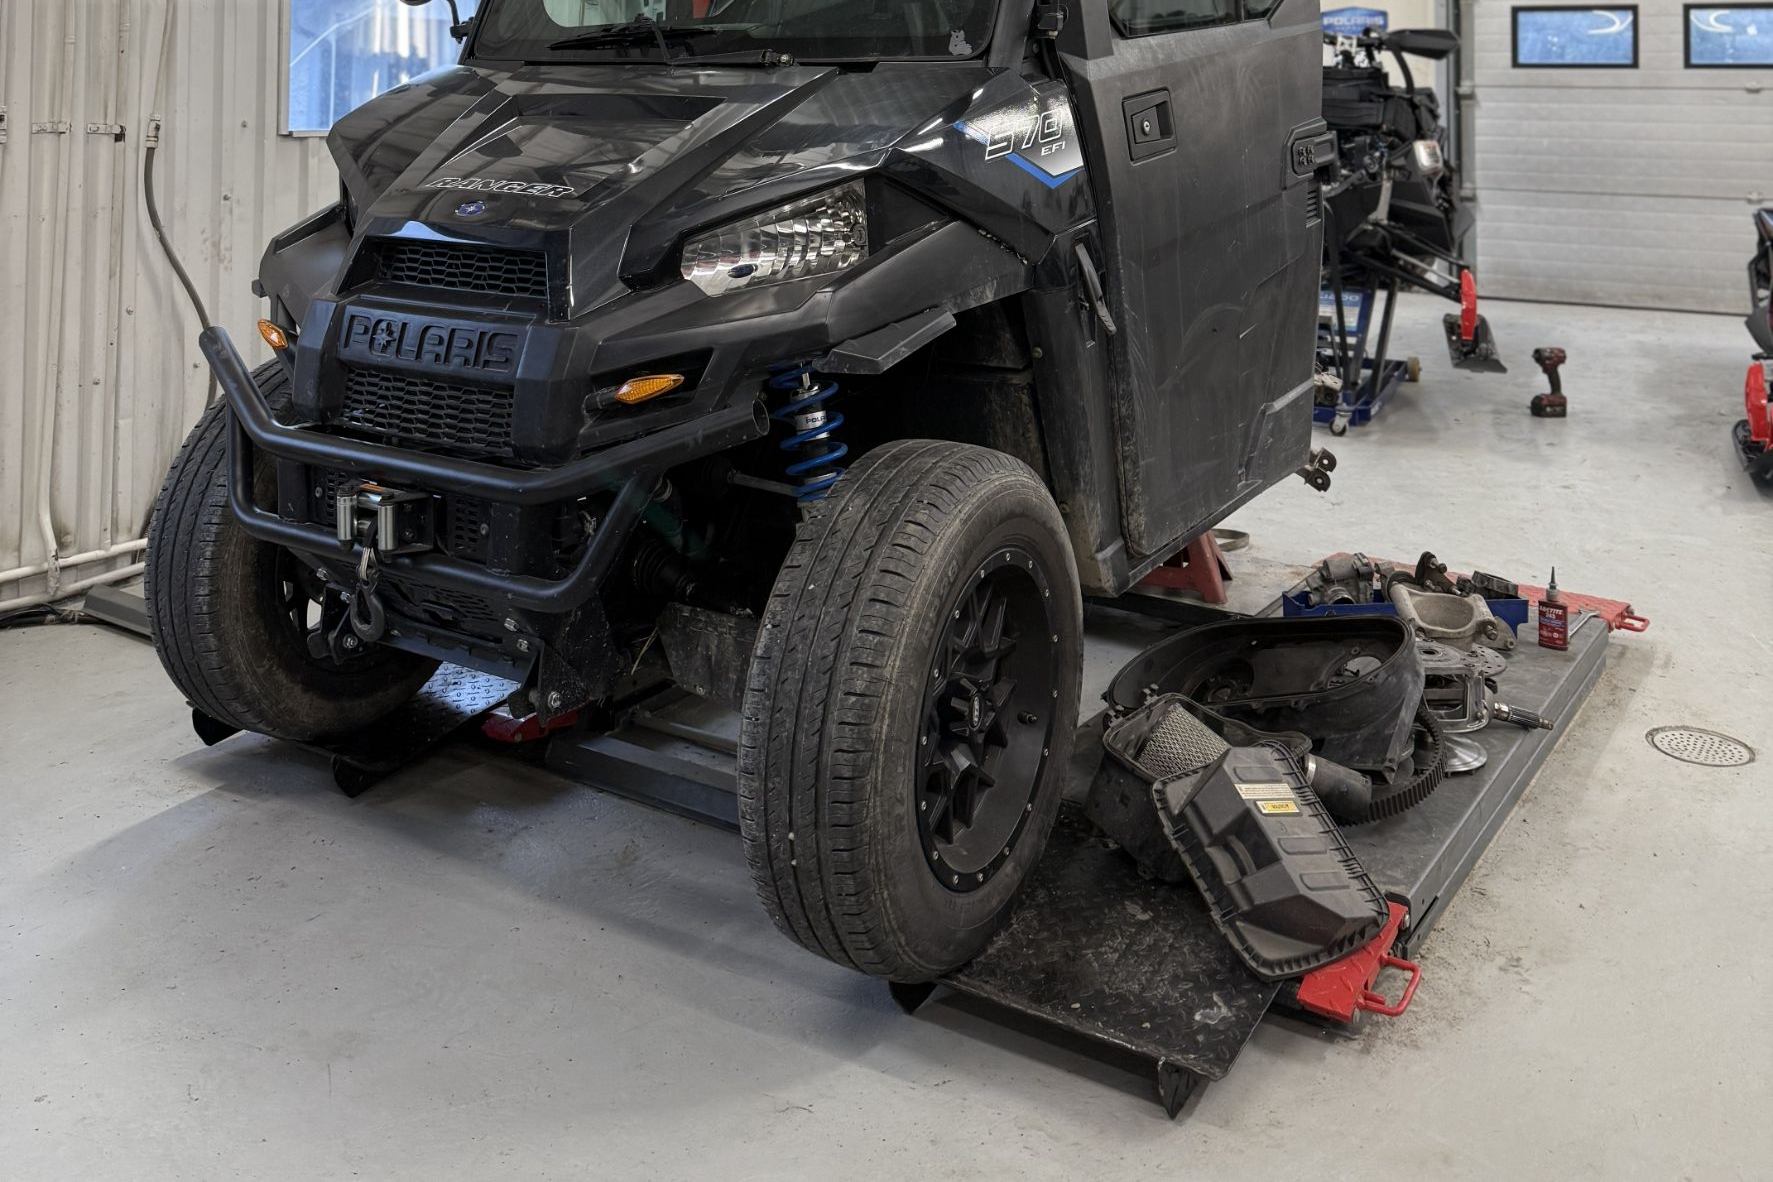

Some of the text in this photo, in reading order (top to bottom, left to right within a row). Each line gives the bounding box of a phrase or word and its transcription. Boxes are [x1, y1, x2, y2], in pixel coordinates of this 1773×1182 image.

[1322, 15, 1385, 26] POLARIS
[985, 110, 1063, 161] 570
[1041, 141, 1066, 156] EFI
[425, 177, 575, 198] RANGER
[345, 315, 518, 371] POLARIS
